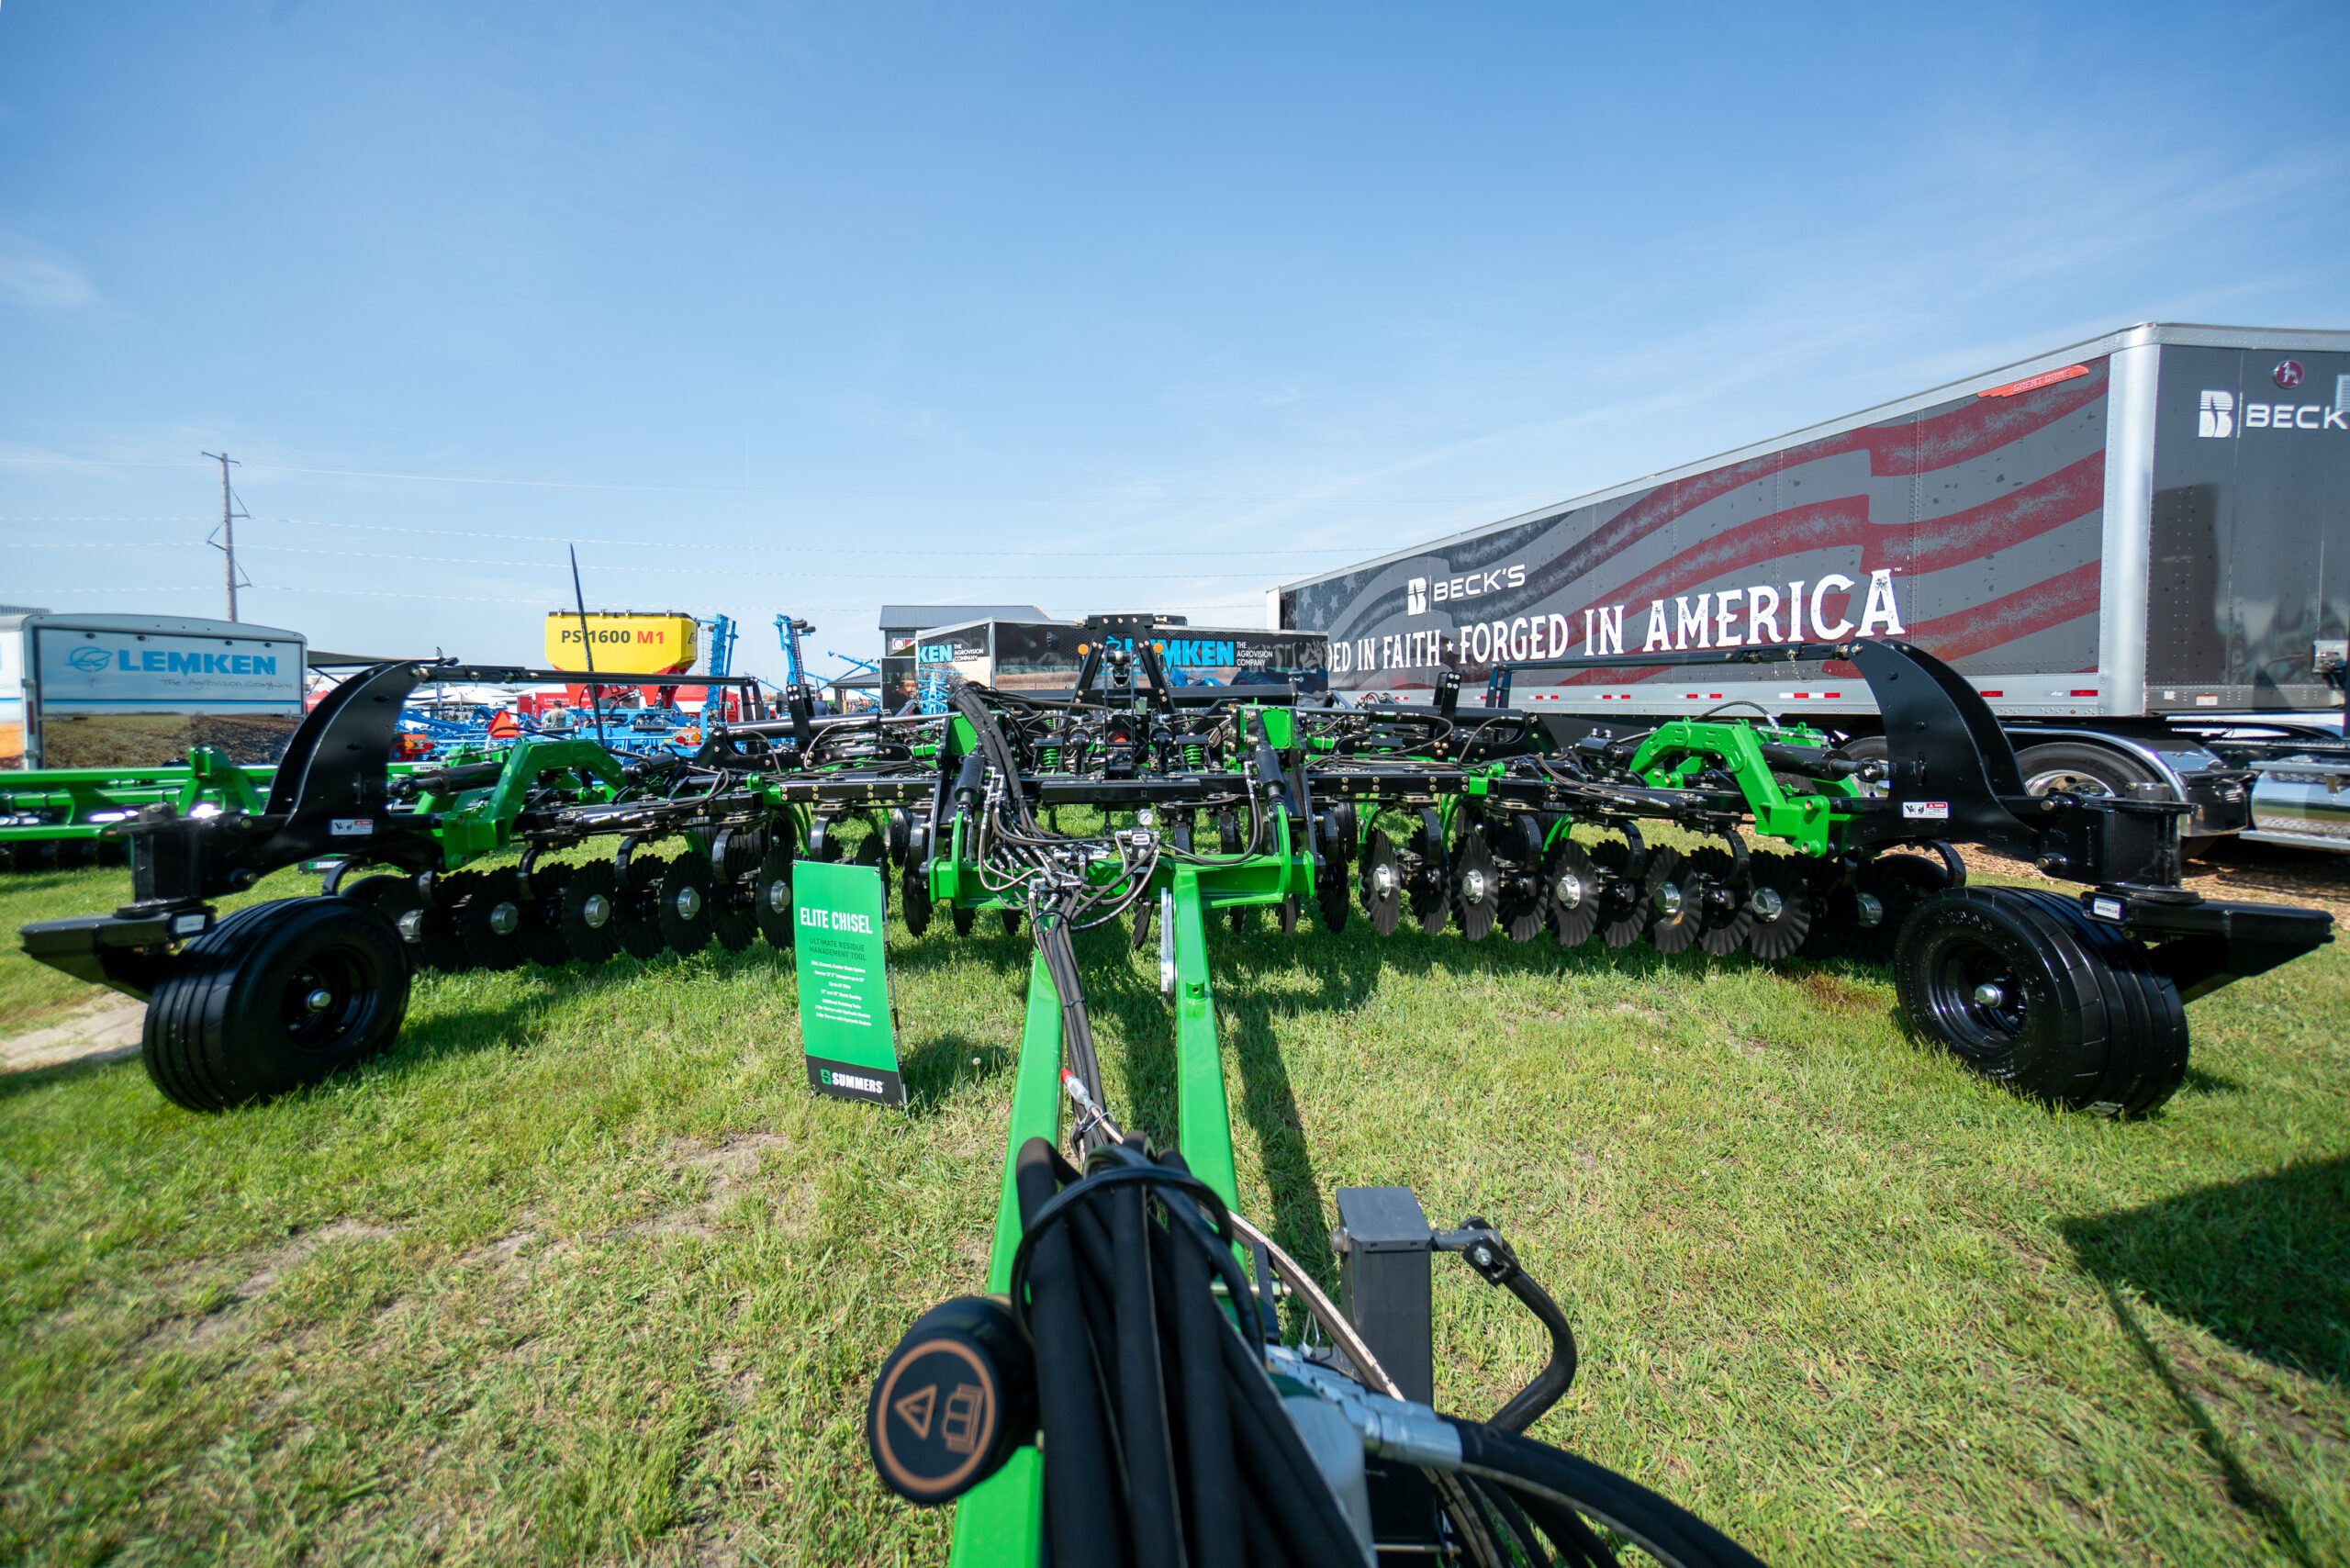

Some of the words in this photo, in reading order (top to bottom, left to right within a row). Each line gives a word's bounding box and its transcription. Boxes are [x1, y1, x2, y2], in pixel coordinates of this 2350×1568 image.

[2013, 376, 2043, 393] GREAT
[2044, 369, 2071, 384] DANE
[1434, 564, 1526, 602] BECK'S
[1357, 637, 1376, 671] IN
[1382, 629, 1441, 670] FAITH
[1460, 613, 1569, 665] FORGED
[1583, 605, 1625, 656] IN
[1642, 568, 1907, 653] AMERICA
[561, 630, 582, 644] PS
[588, 630, 631, 644] 1600
[637, 630, 664, 644] M1
[1236, 641, 1248, 649] THE
[118, 650, 276, 677] LEMKEN
[1125, 638, 1235, 673] LMKEN
[1237, 650, 1273, 658] AGROVISION
[1237, 658, 1266, 666] COMPANY
[159, 678, 182, 687] The
[800, 907, 829, 929] ELITE
[831, 912, 874, 935] CHISEL
[809, 946, 849, 958] MANAGEMENT
[850, 952, 867, 961] TOOL
[810, 937, 838, 948] ULTIMATE
[839, 941, 865, 952] RESIDUE
[832, 1071, 884, 1094] SUMMERS
